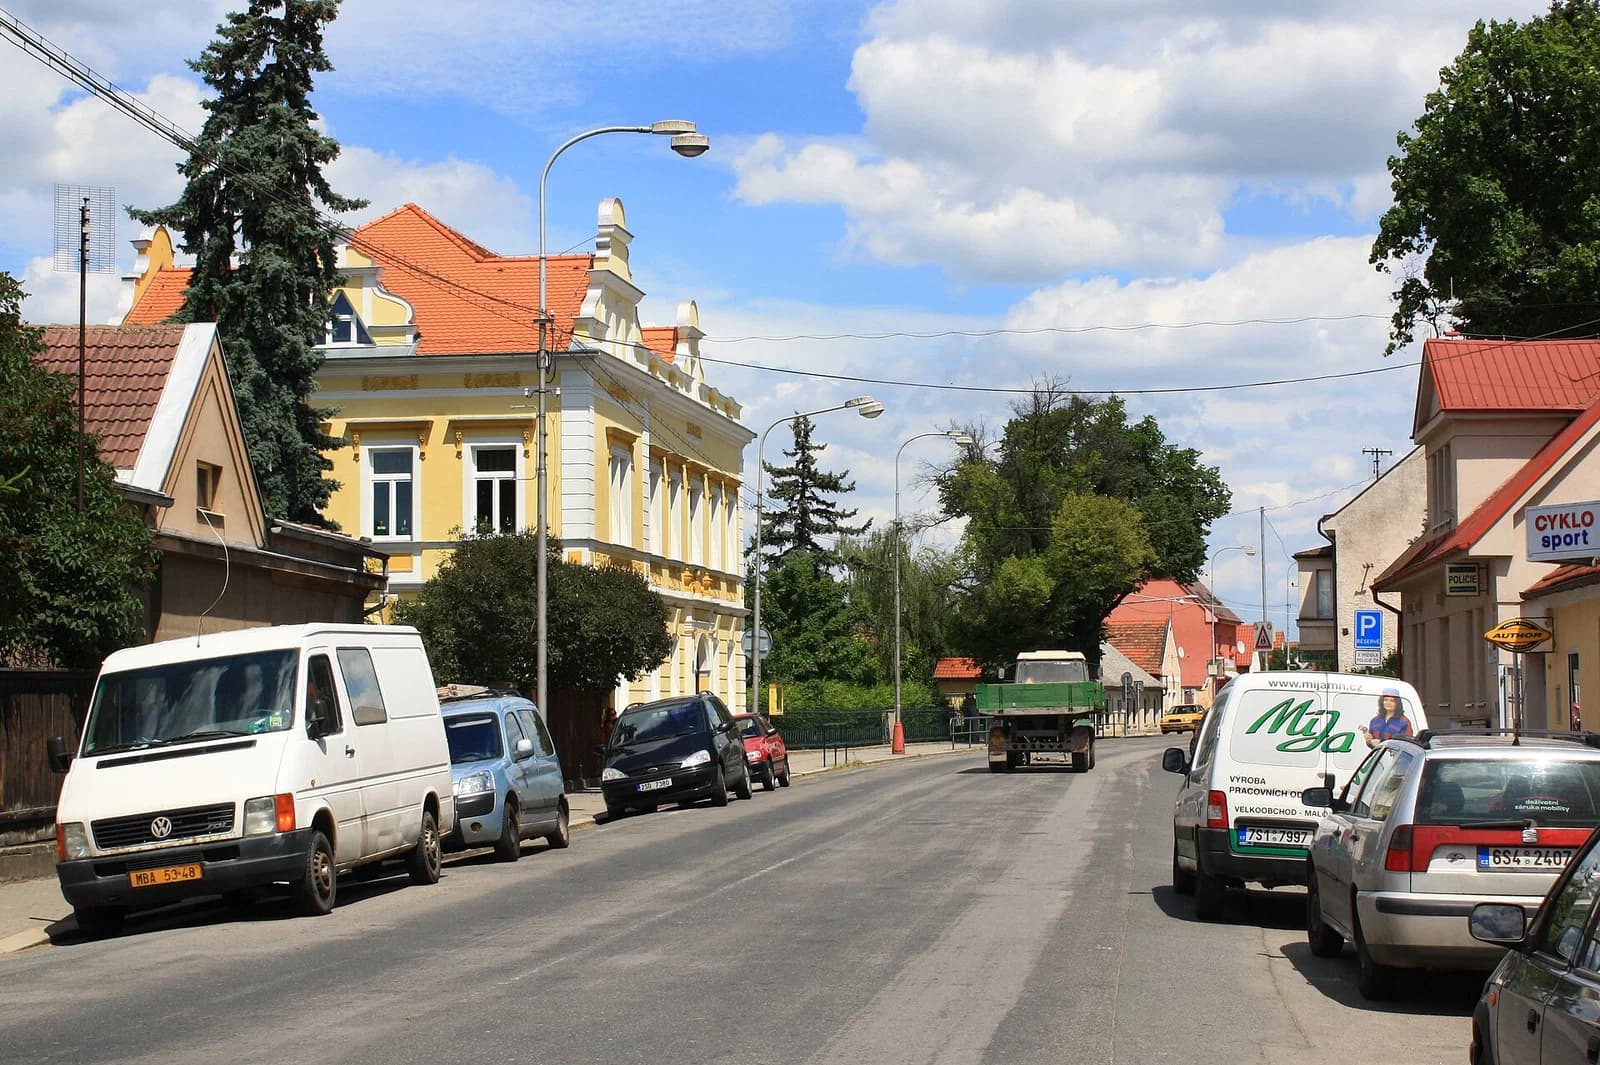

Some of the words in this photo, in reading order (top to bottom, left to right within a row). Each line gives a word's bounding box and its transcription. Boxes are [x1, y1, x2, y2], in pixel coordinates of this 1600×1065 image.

[1535, 511, 1594, 532] CYKLO
[1541, 530, 1589, 550] sport
[1448, 575, 1477, 585] POLICIE
[1361, 615, 1377, 637] P
[1235, 806, 1297, 816] VELKOOBCHOD
[1248, 828, 1270, 841] 7S1
[1279, 830, 1308, 844] 7997
[1492, 849, 1521, 865] 6S4
[1533, 850, 1572, 866] 2407
[135, 870, 156, 885] MBA
